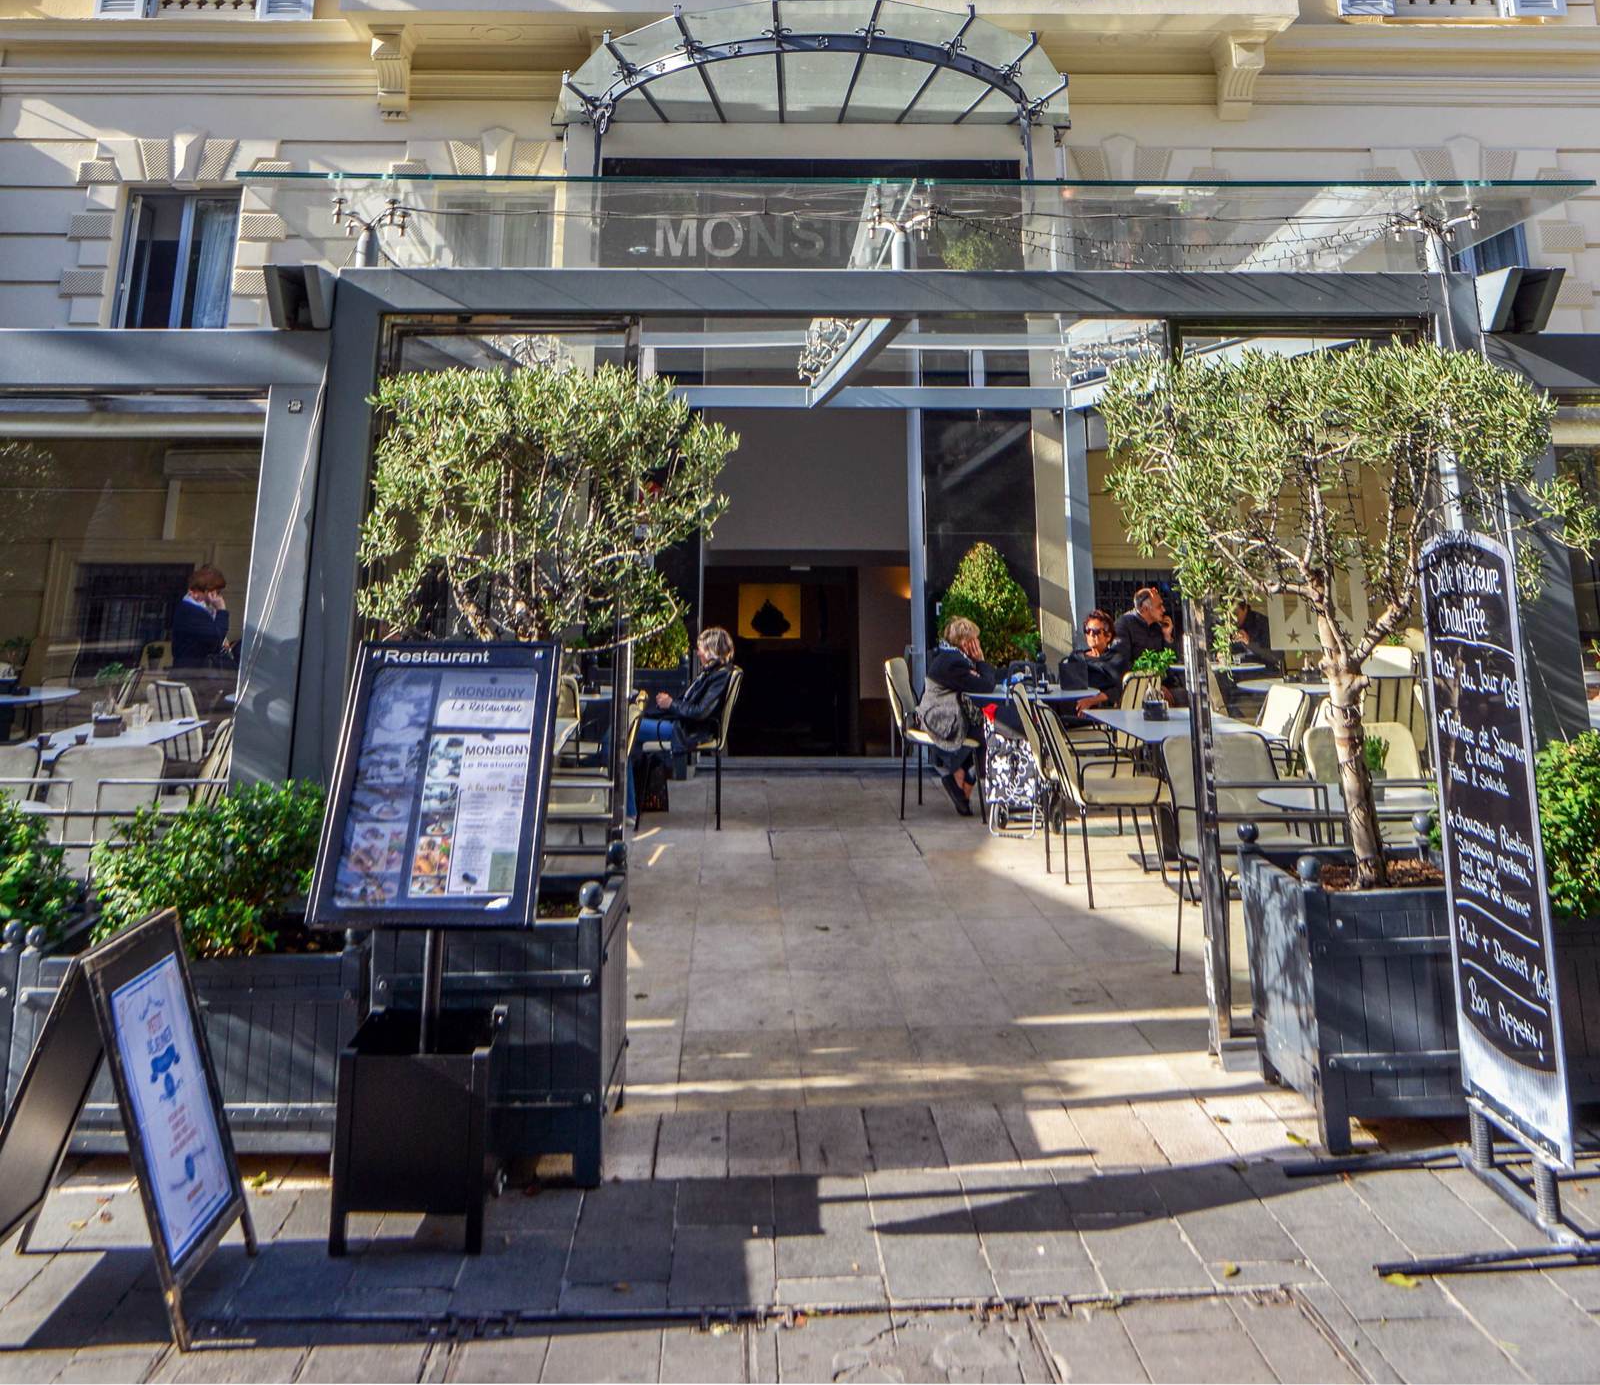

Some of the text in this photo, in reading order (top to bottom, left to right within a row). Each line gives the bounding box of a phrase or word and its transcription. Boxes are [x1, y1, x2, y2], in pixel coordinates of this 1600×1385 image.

[655, 215, 885, 258] MONSI
[1428, 553, 1455, 597] Salle
[1439, 597, 1488, 643] chauffée
[384, 649, 490, 664] Restaurant
[454, 686, 526, 697] MONSIGNY
[1434, 648, 1521, 709] Plat du Jour 13€
[465, 745, 529, 756] MONSIGNY
[1479, 725, 1490, 748] de
[1500, 824, 1535, 872] Riesling
[1491, 886, 1501, 904] de
[1459, 914, 1479, 948] Plat
[1492, 937, 1529, 982] Dessert
[1468, 976, 1491, 1018] Bon
